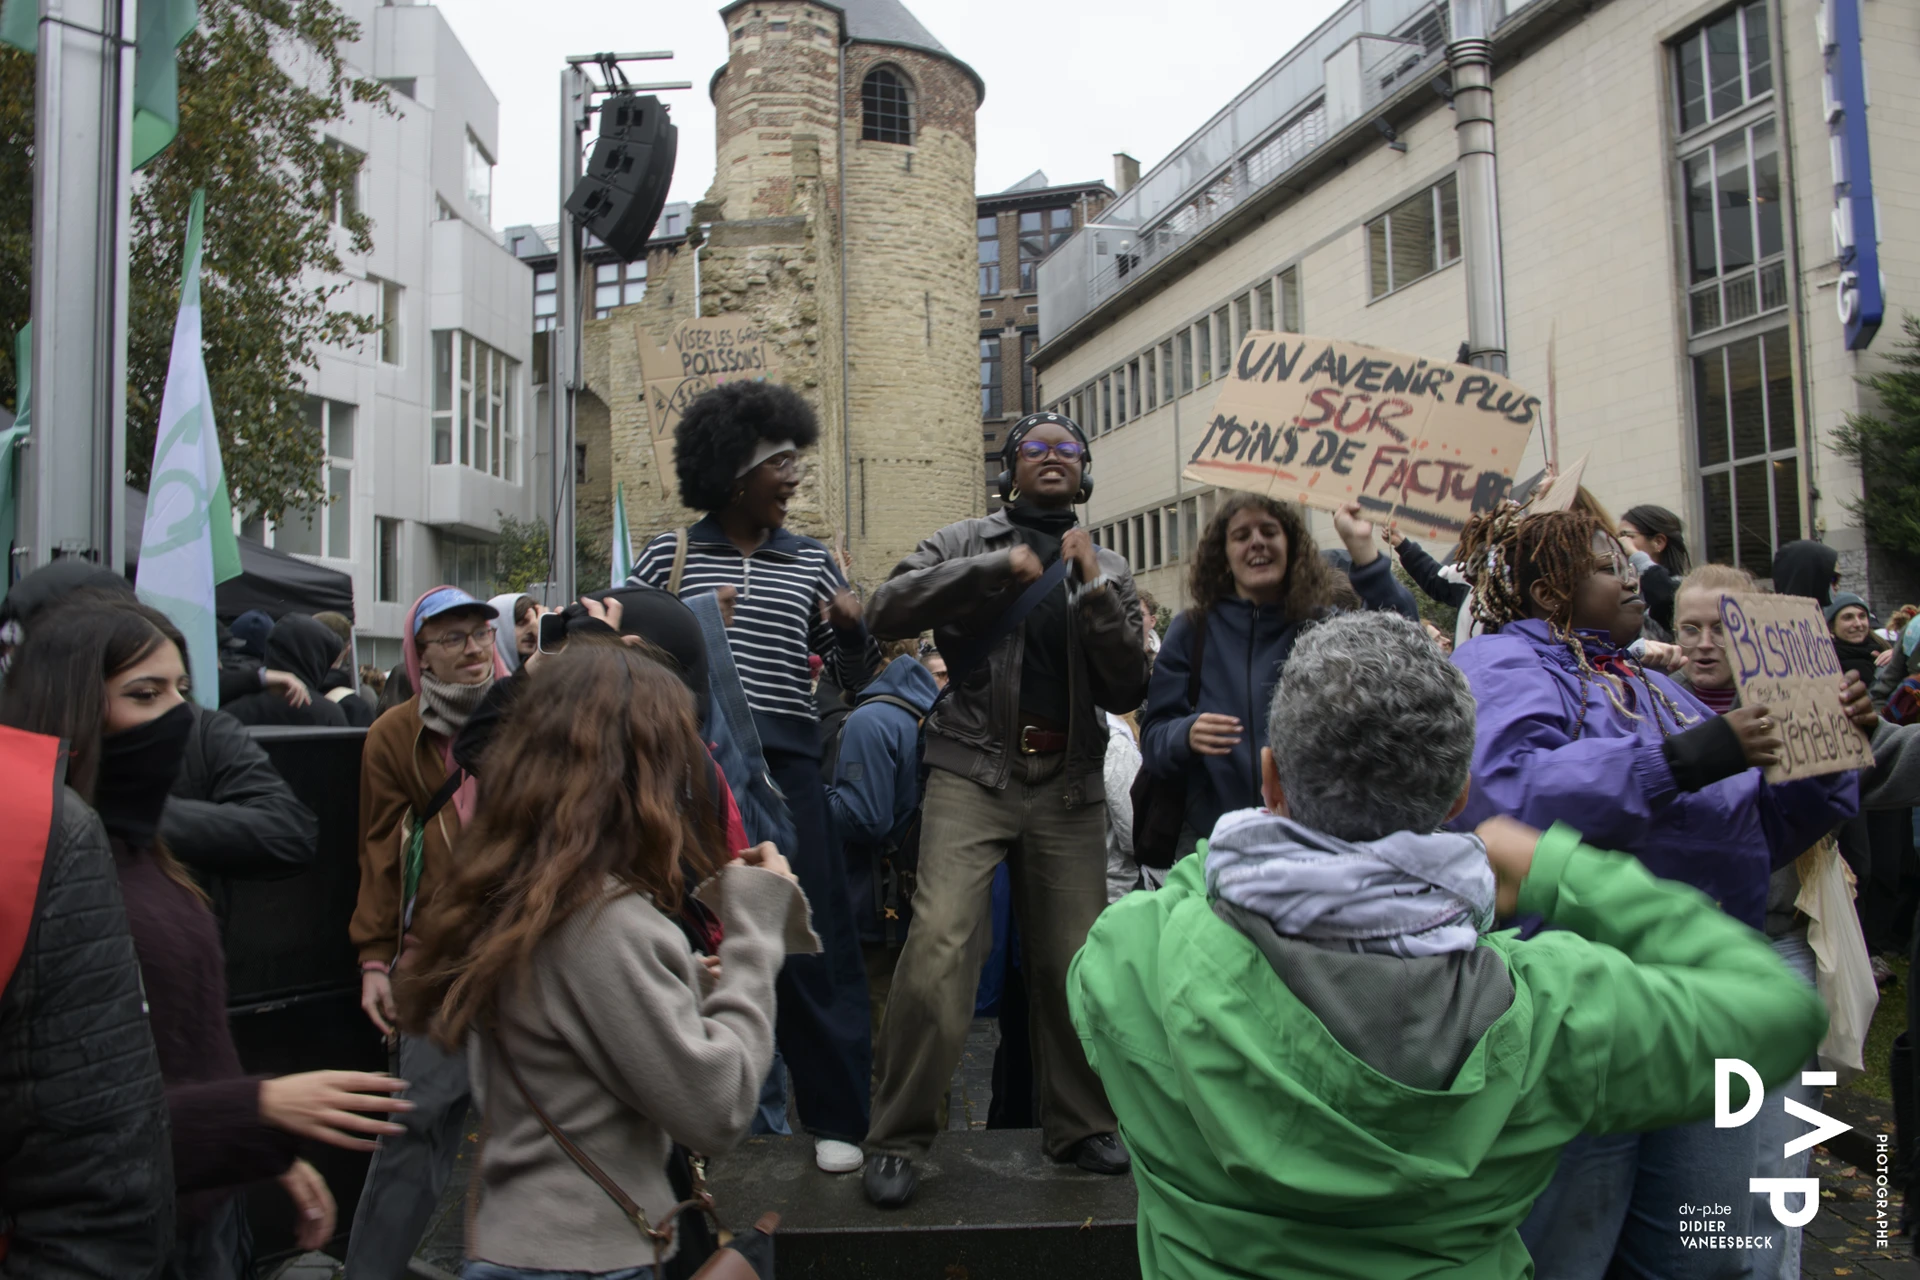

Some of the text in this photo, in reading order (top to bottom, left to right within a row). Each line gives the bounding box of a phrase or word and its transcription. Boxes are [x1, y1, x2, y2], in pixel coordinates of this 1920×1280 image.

[673, 326, 713, 353] VISEZ
[714, 328, 735, 347] LES
[681, 344, 767, 376] POISSONS!
[1237, 339, 1306, 384] UN
[1455, 374, 1541, 424] PLUS
[1301, 429, 1367, 476] DE
